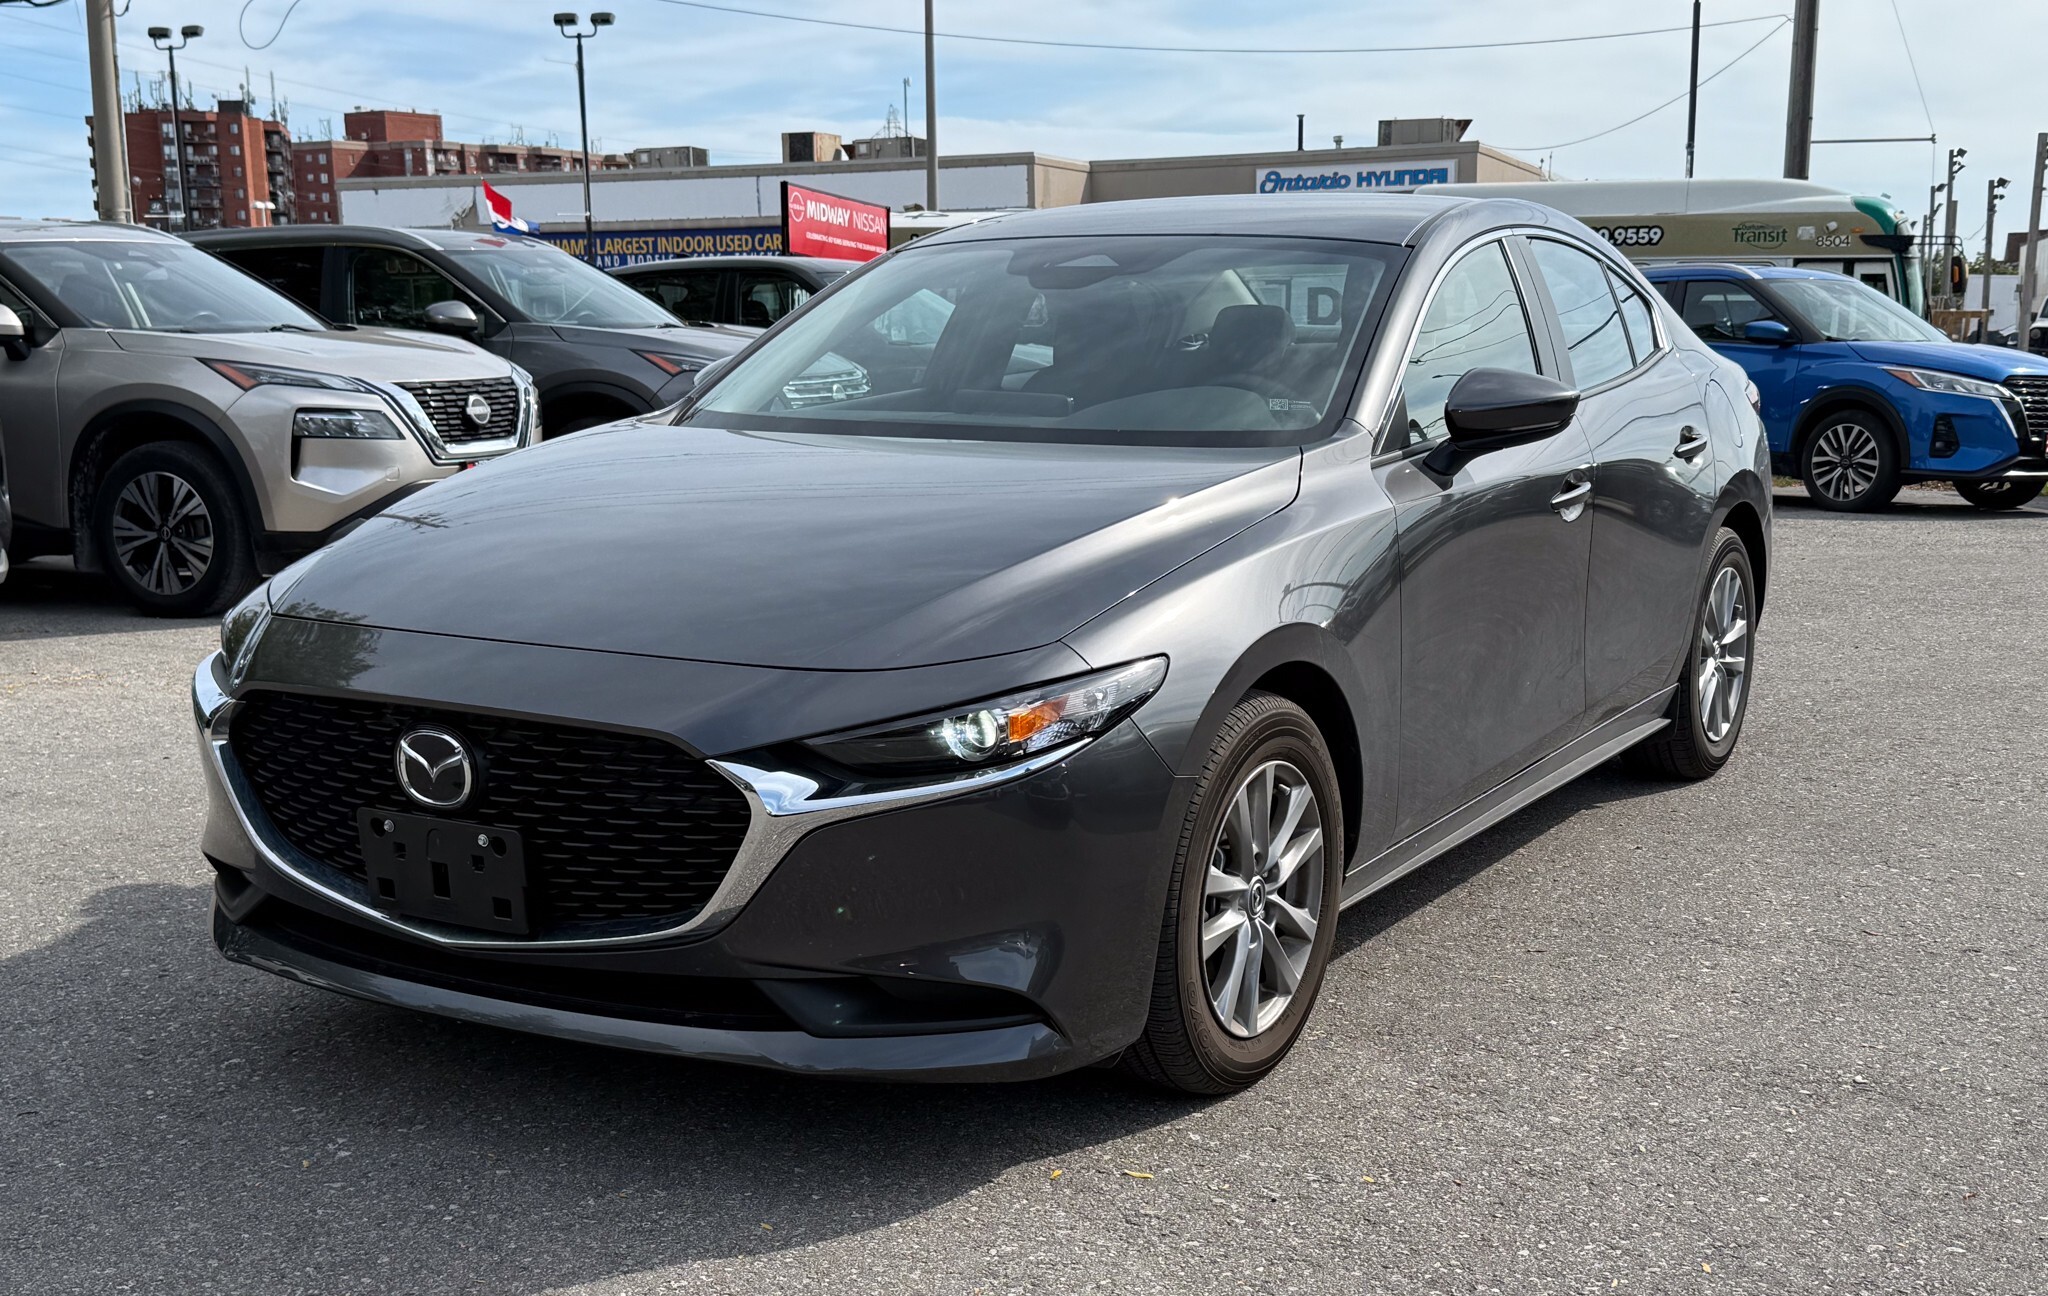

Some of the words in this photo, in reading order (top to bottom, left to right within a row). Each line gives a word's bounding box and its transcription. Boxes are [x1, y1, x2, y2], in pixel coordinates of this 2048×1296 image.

[1259, 170, 1351, 193] Ontario
[1356, 167, 1449, 188] HYUNDAI
[806, 199, 851, 227] MIDWAY
[852, 211, 887, 236] NISSAN
[596, 237, 655, 255] LARGEST
[657, 235, 715, 254] INDOOR
[716, 234, 752, 252] USED
[754, 233, 783, 251] CAR
[1596, 226, 1663, 245] 0.9559
[1731, 227, 1788, 243] Transit
[1816, 235, 1851, 248] 8504
[596, 254, 620, 268] AND
